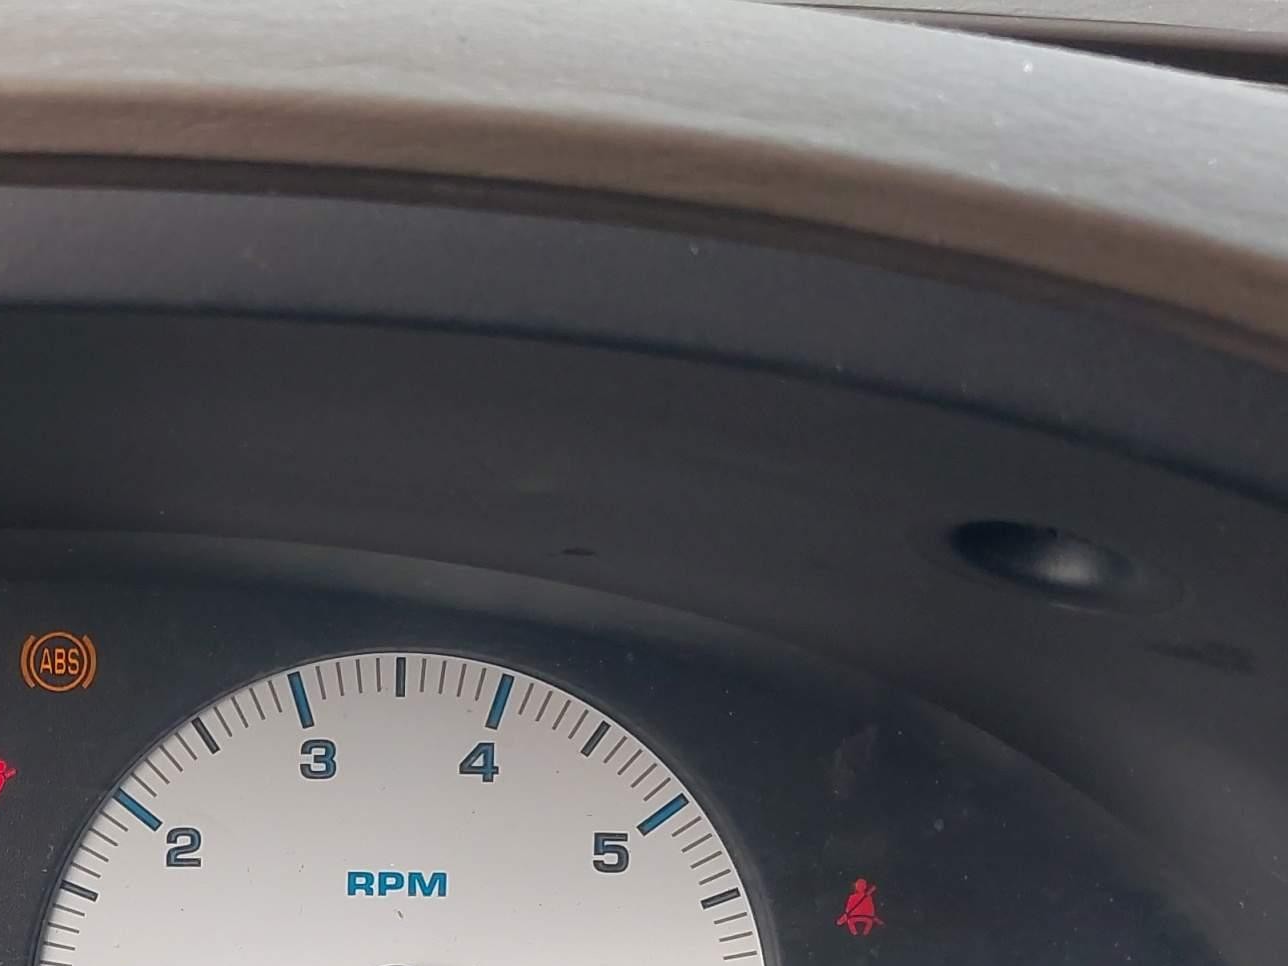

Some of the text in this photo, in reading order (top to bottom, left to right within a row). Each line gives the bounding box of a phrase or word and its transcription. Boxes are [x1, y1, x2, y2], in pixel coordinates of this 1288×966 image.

[39, 648, 80, 674] ABS
[298, 738, 337, 780] 3
[458, 741, 499, 783] 4
[165, 826, 203, 868] 2
[592, 832, 630, 873] 5
[346, 870, 448, 897] RPM
